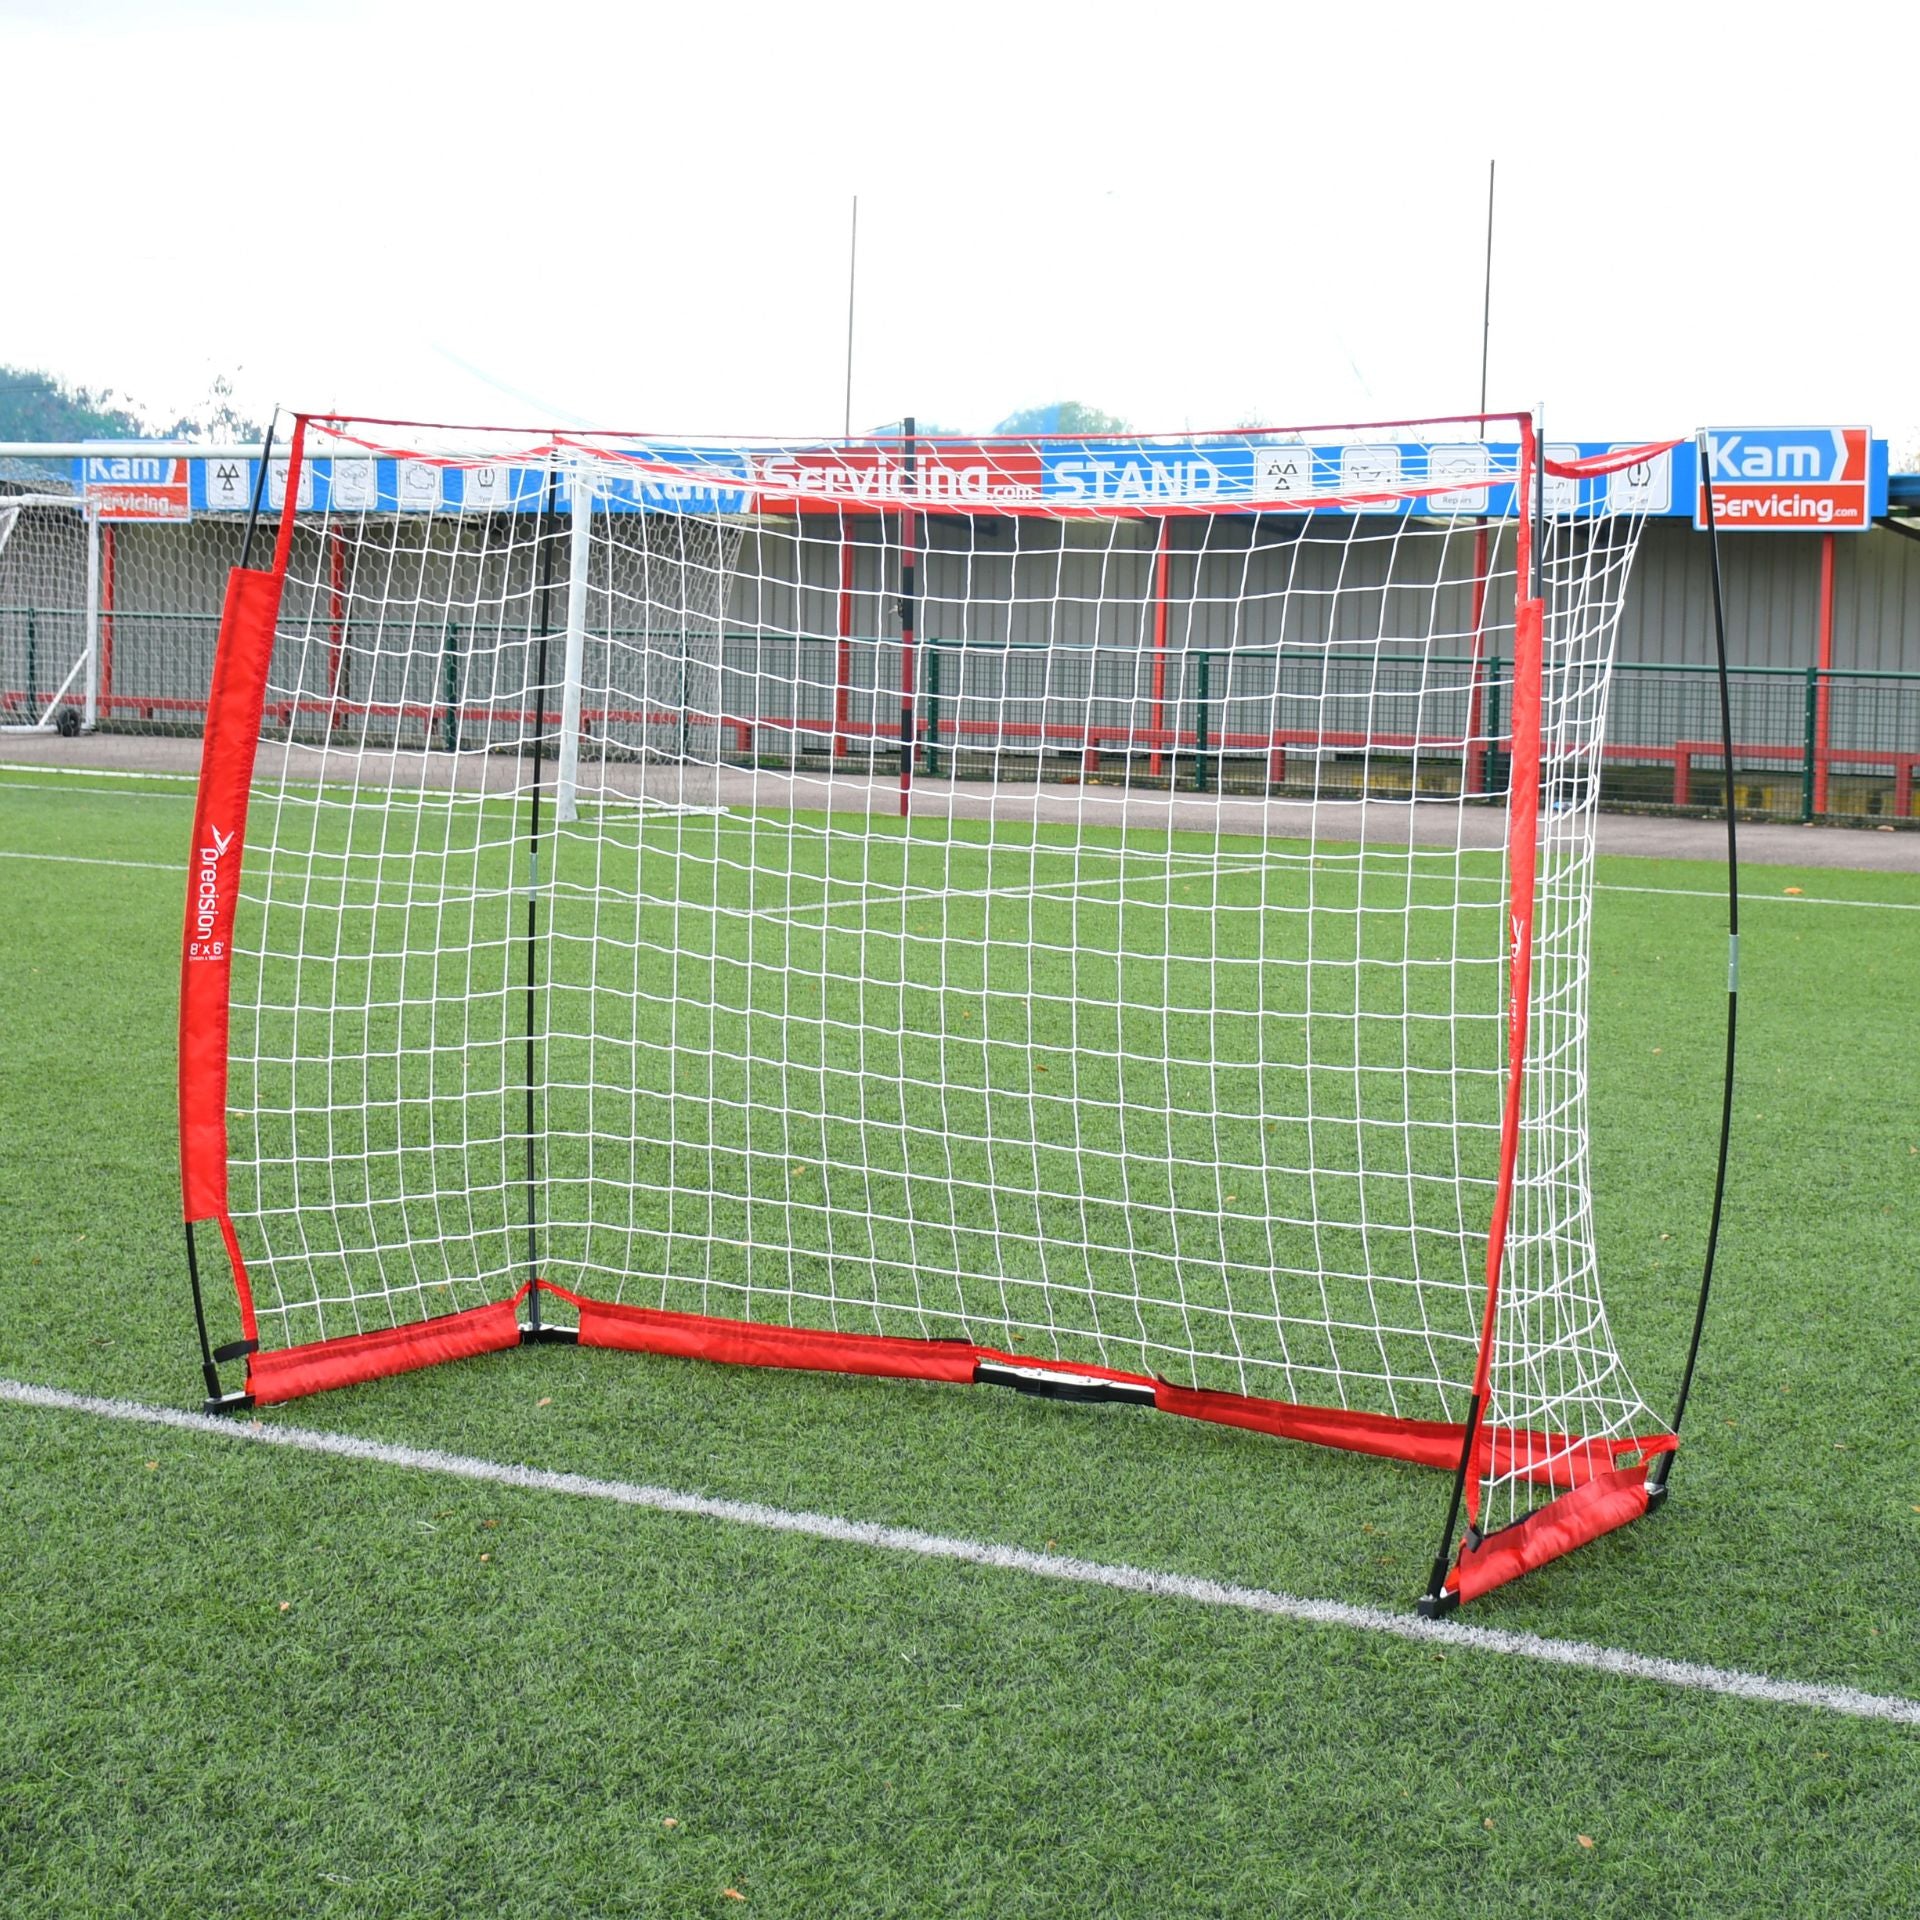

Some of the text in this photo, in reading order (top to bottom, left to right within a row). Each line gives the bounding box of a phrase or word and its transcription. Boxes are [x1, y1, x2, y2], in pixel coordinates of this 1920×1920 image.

[89, 457, 160, 480] Kam
[1706, 436, 1820, 477] Kam
[1053, 461, 1219, 499] STAND
[1712, 494, 1858, 523] Servicing.com
[197, 848, 219, 940] precision
[203, 944, 210, 955] x
